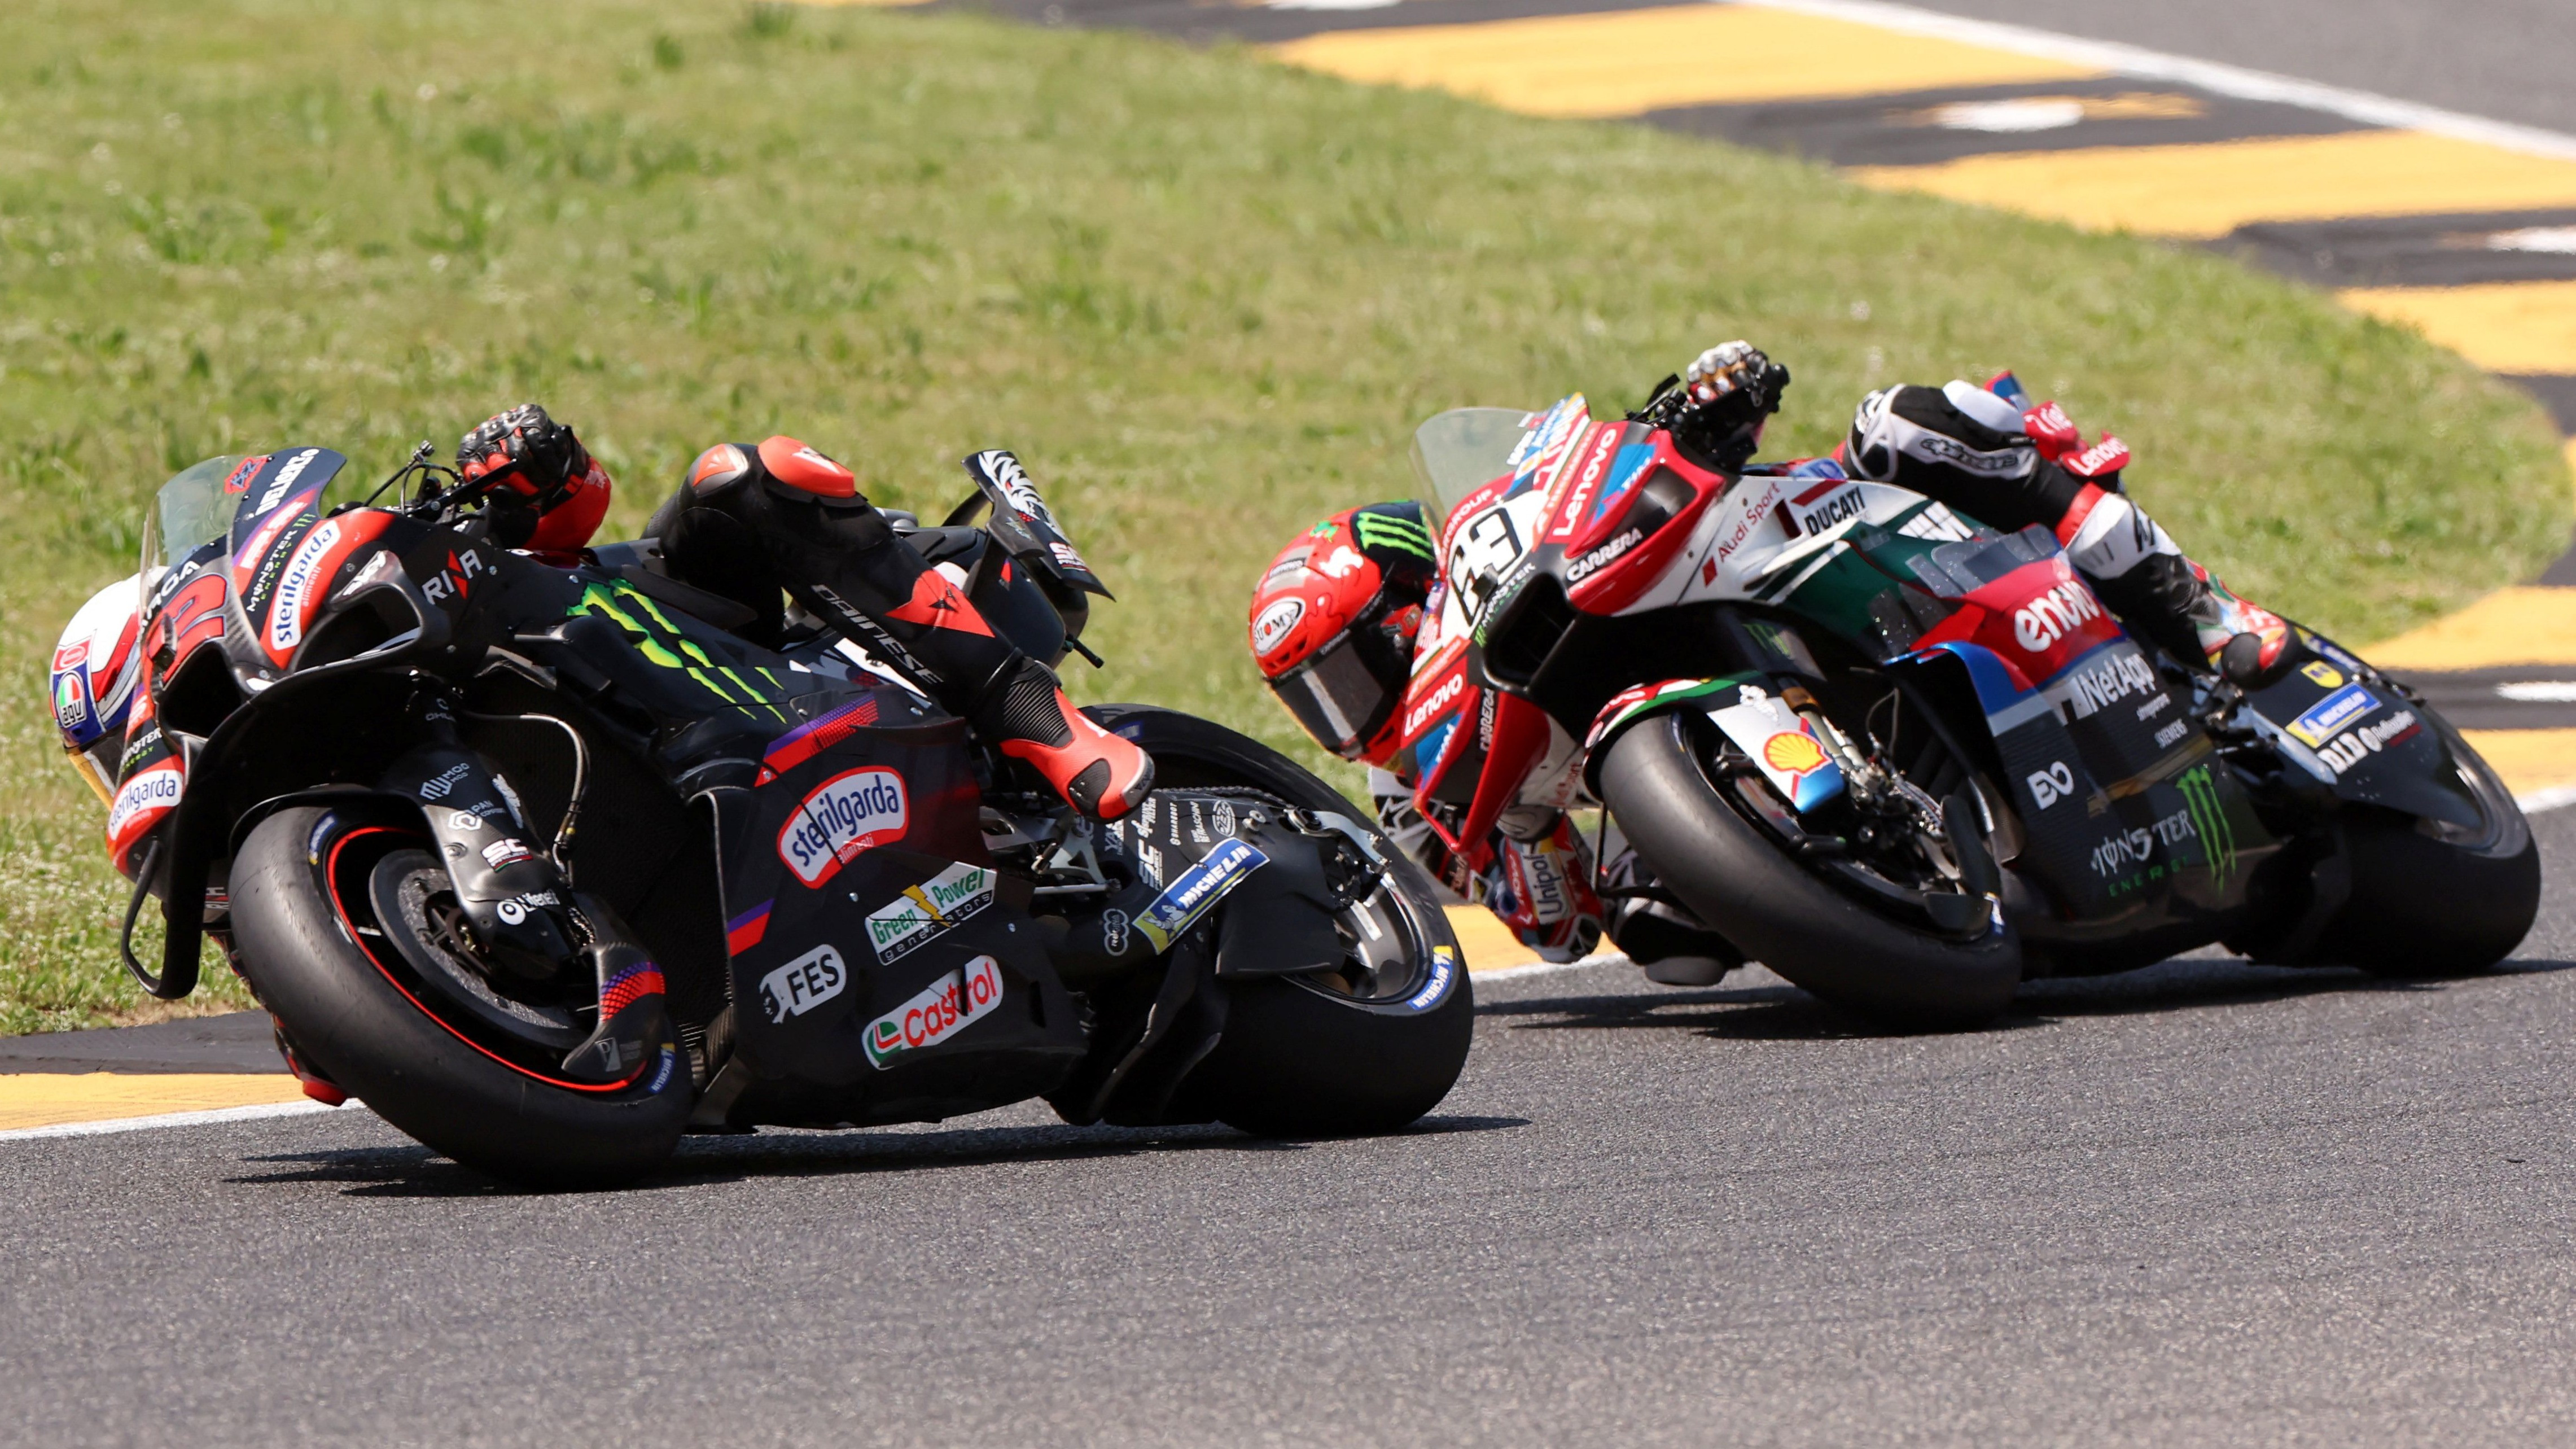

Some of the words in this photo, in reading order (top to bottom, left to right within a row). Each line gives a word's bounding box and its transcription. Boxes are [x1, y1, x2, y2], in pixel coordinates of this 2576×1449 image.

[1553, 428, 1618, 536] Lenovo
[2068, 436, 2129, 476] Lenovo
[1718, 516, 1747, 563] Audi
[1746, 481, 1781, 525] Sport
[1804, 487, 1866, 537] DUCATI
[246, 529, 298, 612] MONSTER
[278, 527, 333, 643] sterilgarda
[422, 545, 483, 605] RINA
[1566, 527, 1643, 582] CARRERA
[301, 566, 322, 607] alimenti
[811, 584, 944, 685] DAINESE
[1254, 606, 1298, 644] SUOMY
[1404, 673, 1463, 737] Lenovo
[2077, 653, 2157, 713] NetApp
[792, 774, 900, 867] sterilgarda
[873, 908, 917, 944] Green
[931, 868, 986, 908] Power
[1177, 845, 1252, 910] MICHELIN
[1522, 853, 1562, 916] Unipol
[787, 953, 840, 1005] FES
[905, 961, 998, 1048] Castrol
[1412, 964, 1449, 1008] MICHELIN
